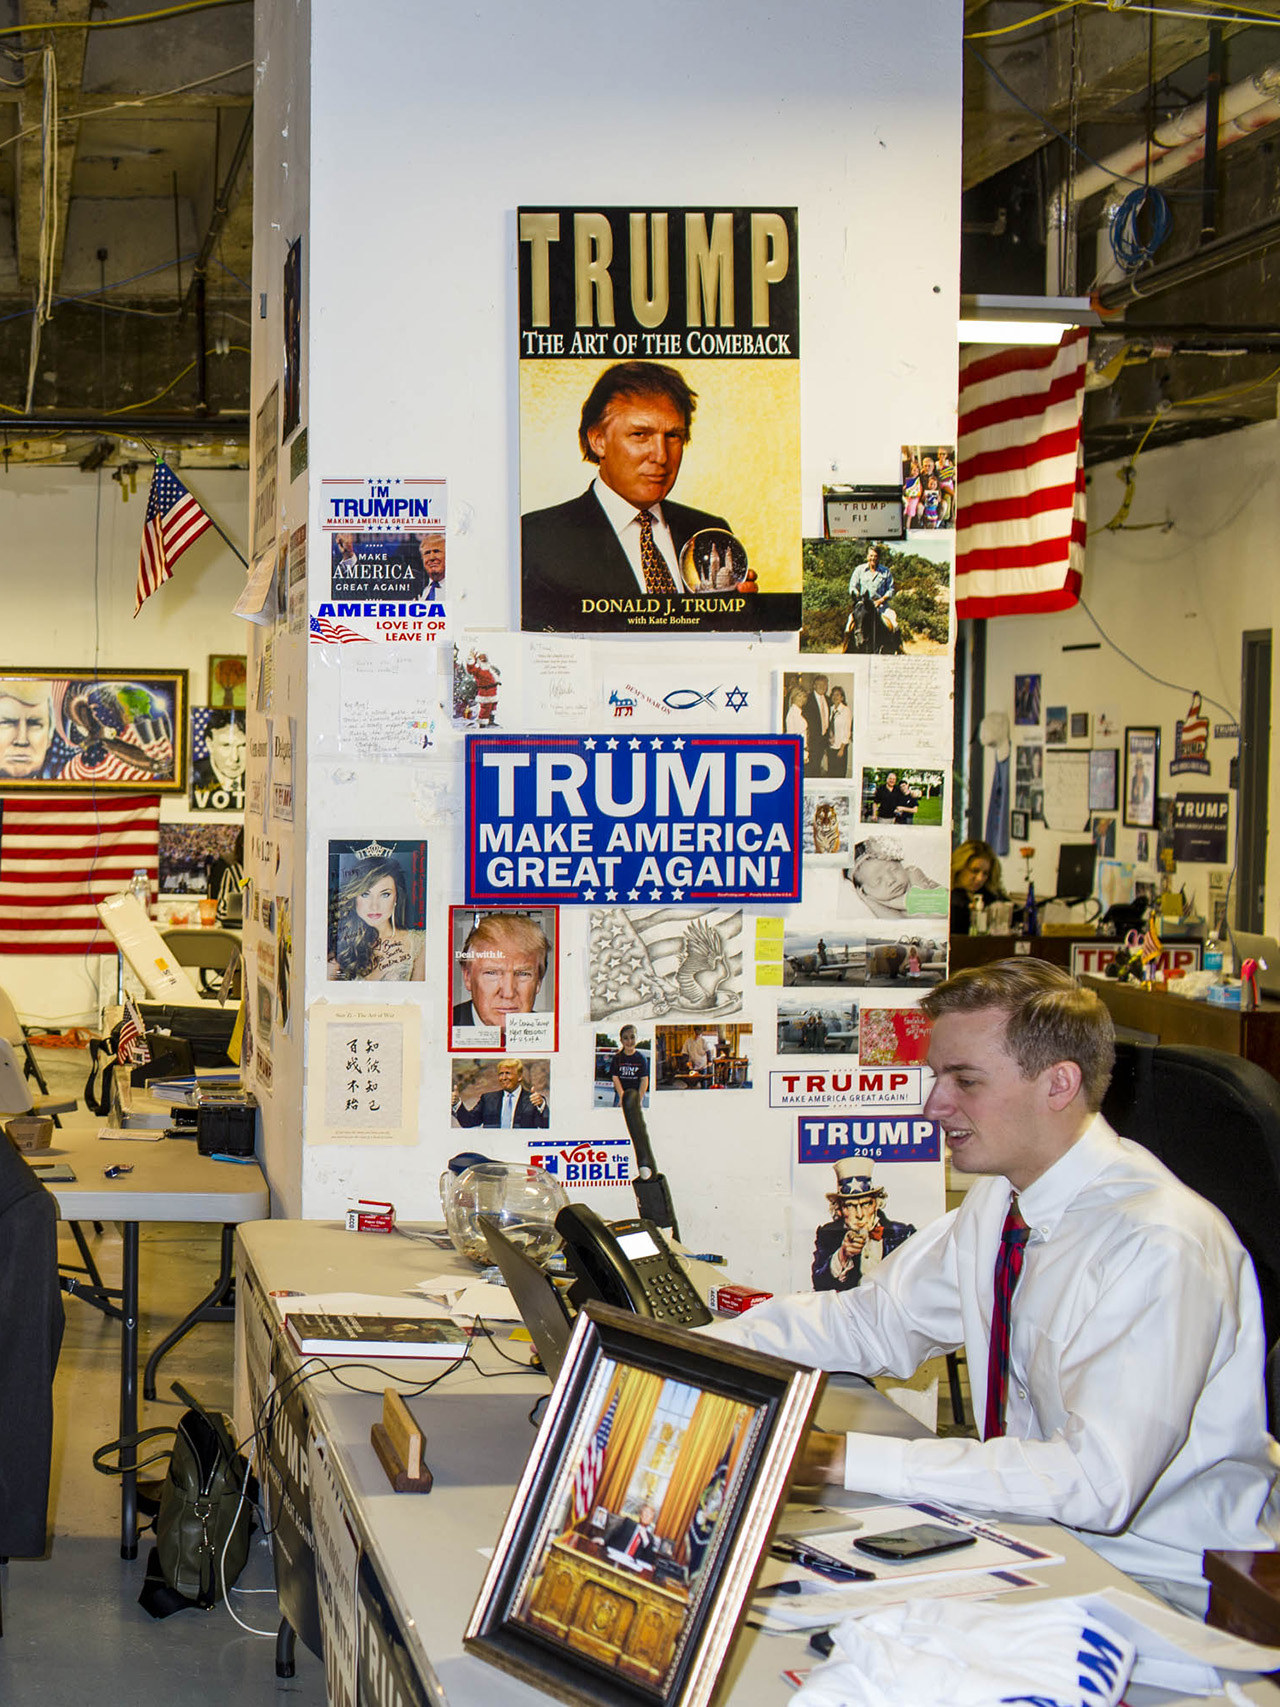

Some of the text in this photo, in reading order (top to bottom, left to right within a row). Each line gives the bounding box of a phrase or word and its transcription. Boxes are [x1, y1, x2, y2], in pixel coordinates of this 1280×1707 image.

[520, 213, 790, 328] TRUMP
[523, 330, 791, 355] THE ART OF THE COMEBACK
[371, 486, 389, 498] I'M
[330, 499, 432, 517] TRUMPIN'
[332, 564, 415, 579] AMERICA
[373, 583, 410, 591] AGAIN!
[317, 603, 446, 617] AMERICA
[581, 598, 746, 616] DONALD J. TRUMP
[376, 622, 446, 630] LOVE IT OR
[627, 616, 700, 624] with Kate Bohner
[386, 633, 436, 641] LEAVE IT
[482, 752, 787, 817] TRUMP
[194, 790, 246, 809] VOT
[1176, 801, 1228, 818] TRUMP
[479, 823, 791, 852] MAKE AMERICA
[486, 856, 780, 888] GREAT AGAIN!
[455, 951, 506, 959] Deal with it.
[782, 1074, 908, 1093] TRUMP
[782, 1093, 908, 1103] MAKE AMERICA GREAT AGAIN!
[804, 1121, 934, 1146] TRUMP
[560, 1143, 629, 1163] Vote the
[854, 1148, 882, 1157] 2016
[566, 1163, 629, 1180] BIBLE
